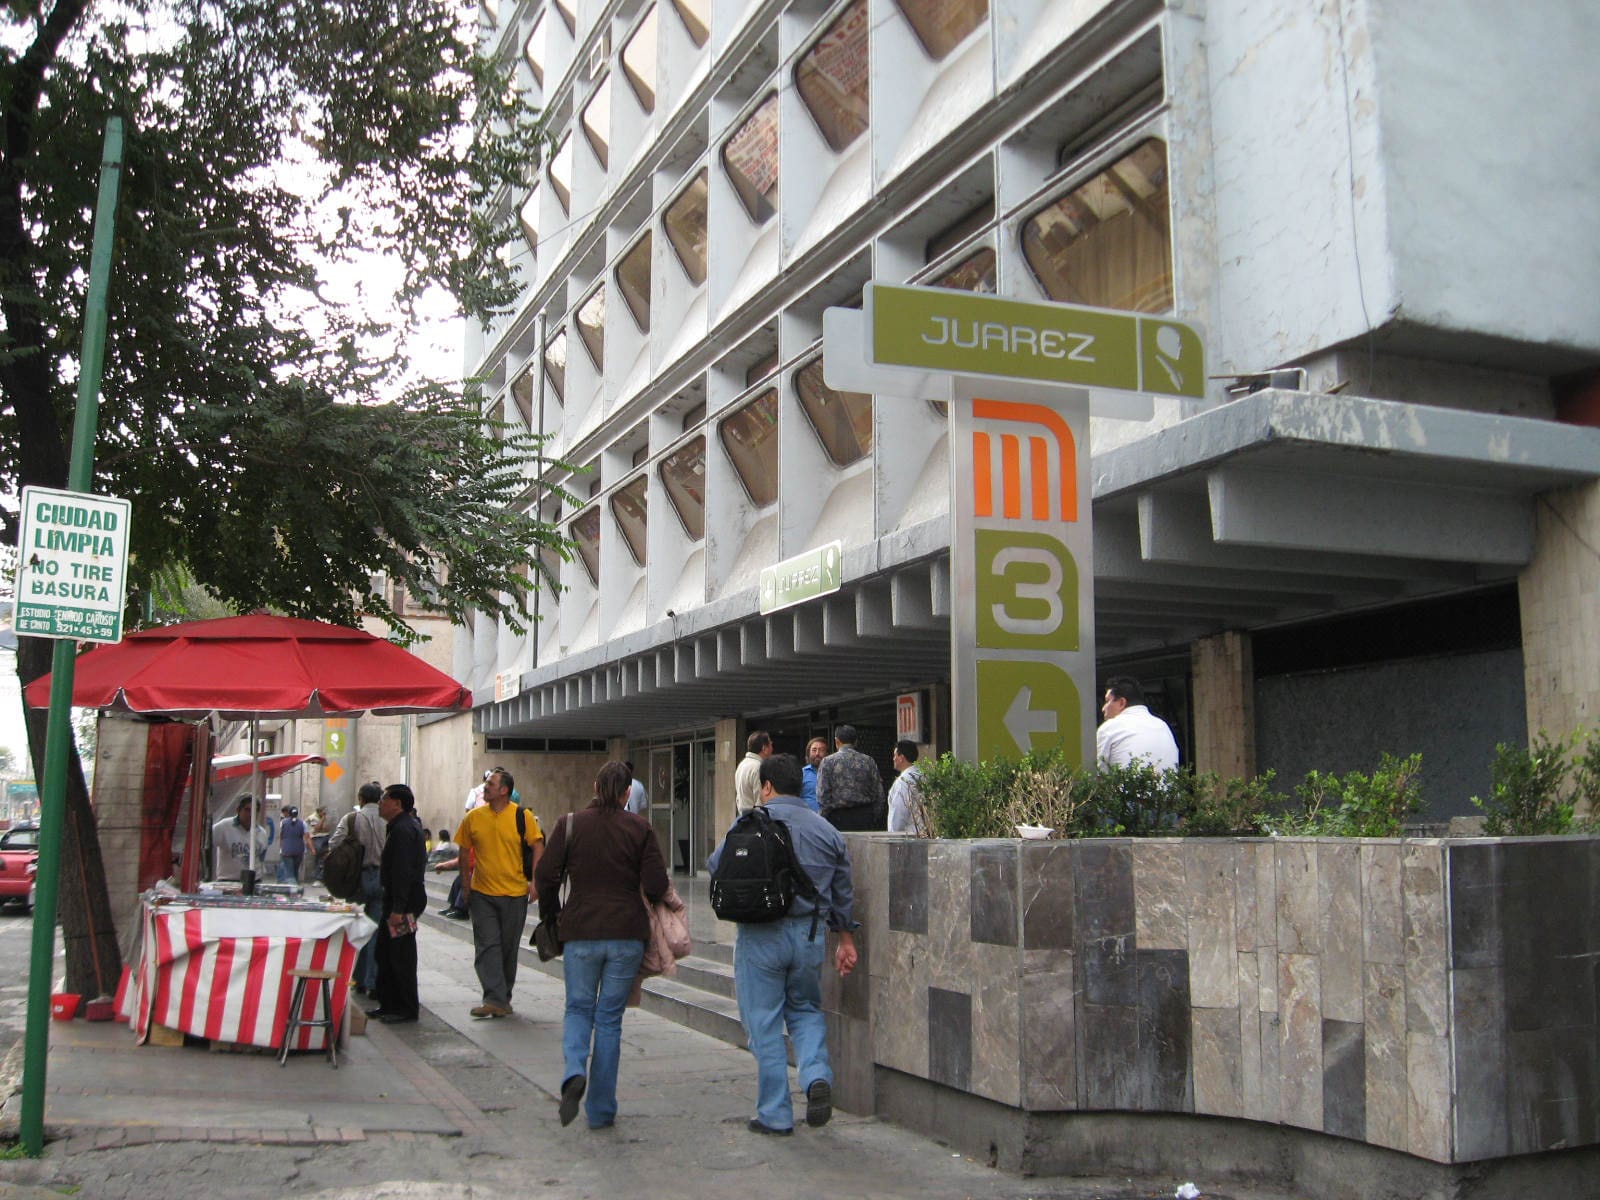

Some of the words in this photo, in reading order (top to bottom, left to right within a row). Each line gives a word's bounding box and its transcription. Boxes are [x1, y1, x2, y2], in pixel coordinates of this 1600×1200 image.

[921, 316, 1096, 363] JUAREZ
[36, 502, 118, 531] CIUDAD
[34, 528, 114, 557] LIMPIA
[32, 558, 59, 575] NO
[70, 562, 113, 582] TIRE
[31, 581, 110, 602] BASURA
[992, 546, 1063, 635] 3
